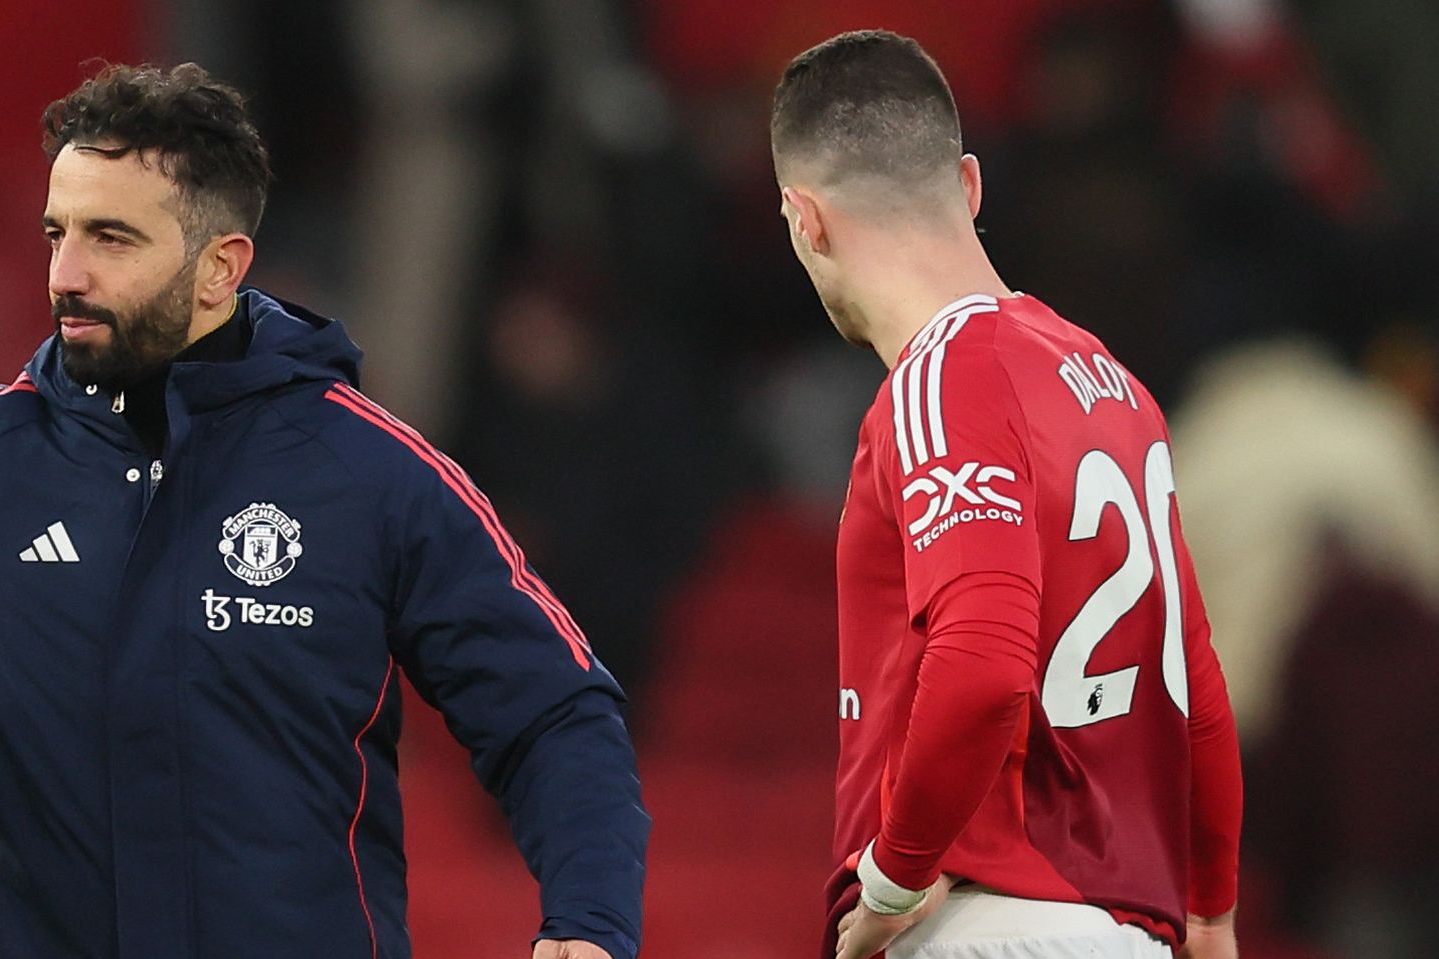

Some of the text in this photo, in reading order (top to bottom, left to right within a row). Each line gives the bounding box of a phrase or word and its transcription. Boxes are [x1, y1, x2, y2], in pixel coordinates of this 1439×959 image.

[1058, 352, 1138, 415] DALOT
[902, 462, 1022, 537] DXC
[229, 509, 296, 538] MANCHESTER
[913, 508, 1024, 553] TECHNOLOGY
[236, 564, 283, 581] UNITED
[235, 597, 314, 627] Tezos
